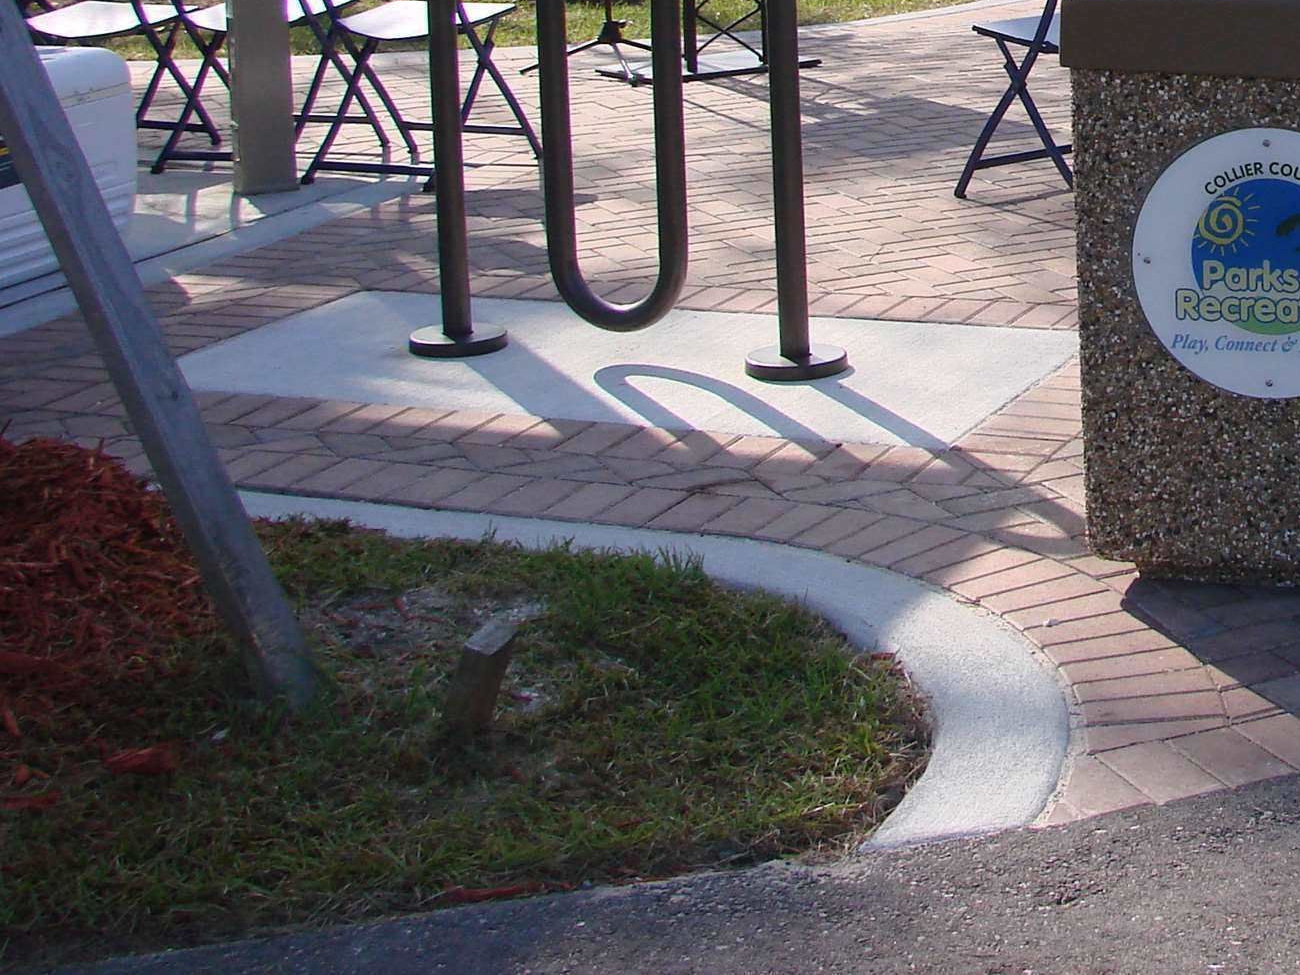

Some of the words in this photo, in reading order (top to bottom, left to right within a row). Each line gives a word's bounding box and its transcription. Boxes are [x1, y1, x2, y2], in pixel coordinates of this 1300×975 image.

[1204, 161, 1264, 195] COLLIER
[1201, 259, 1300, 294] Parks
[1171, 333, 1209, 355] Play,
[1214, 334, 1279, 353] Connect
[1281, 336, 1298, 353] &
